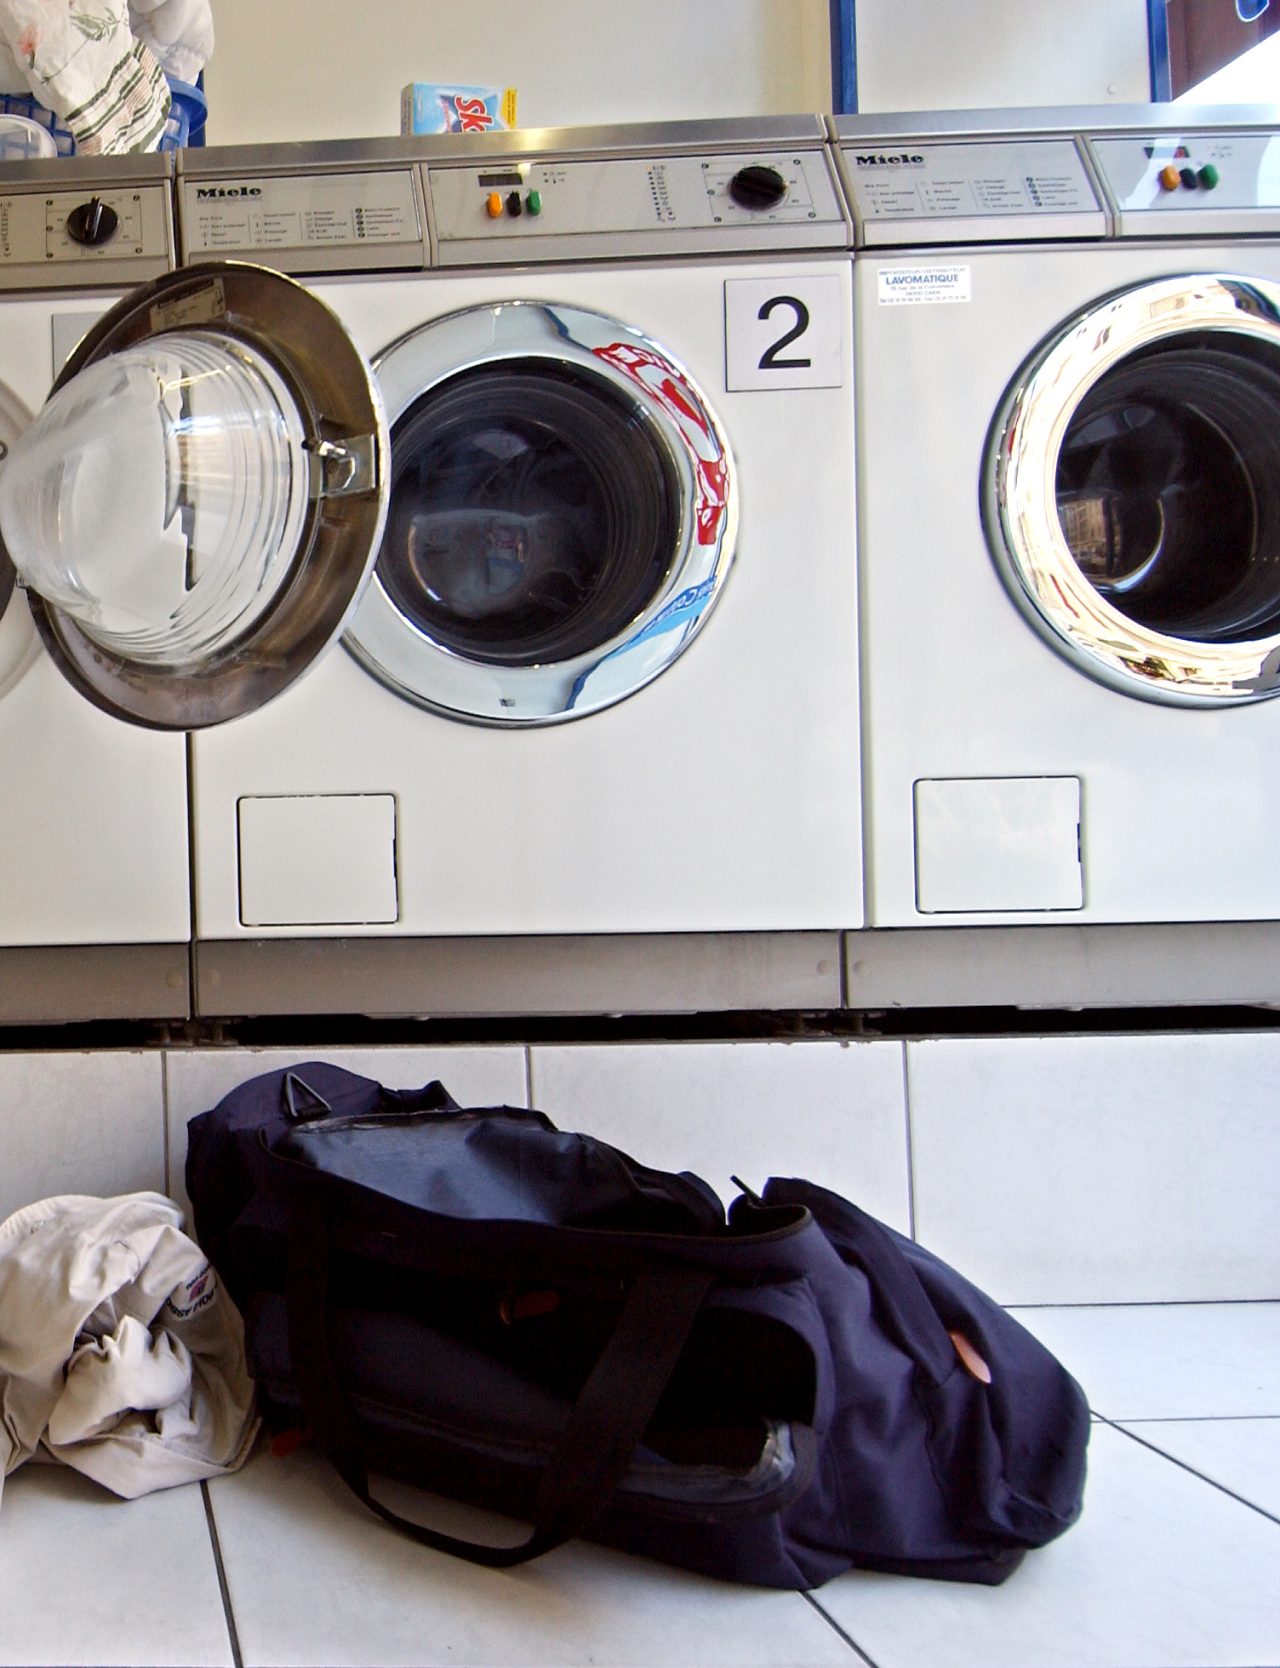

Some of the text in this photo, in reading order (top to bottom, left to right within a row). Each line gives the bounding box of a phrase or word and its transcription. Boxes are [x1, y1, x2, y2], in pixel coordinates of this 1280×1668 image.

[855, 153, 925, 166] Miele
[196, 186, 262, 199] Miele
[885, 273, 959, 286] LAVOMATIQUE
[757, 295, 811, 369] 2
